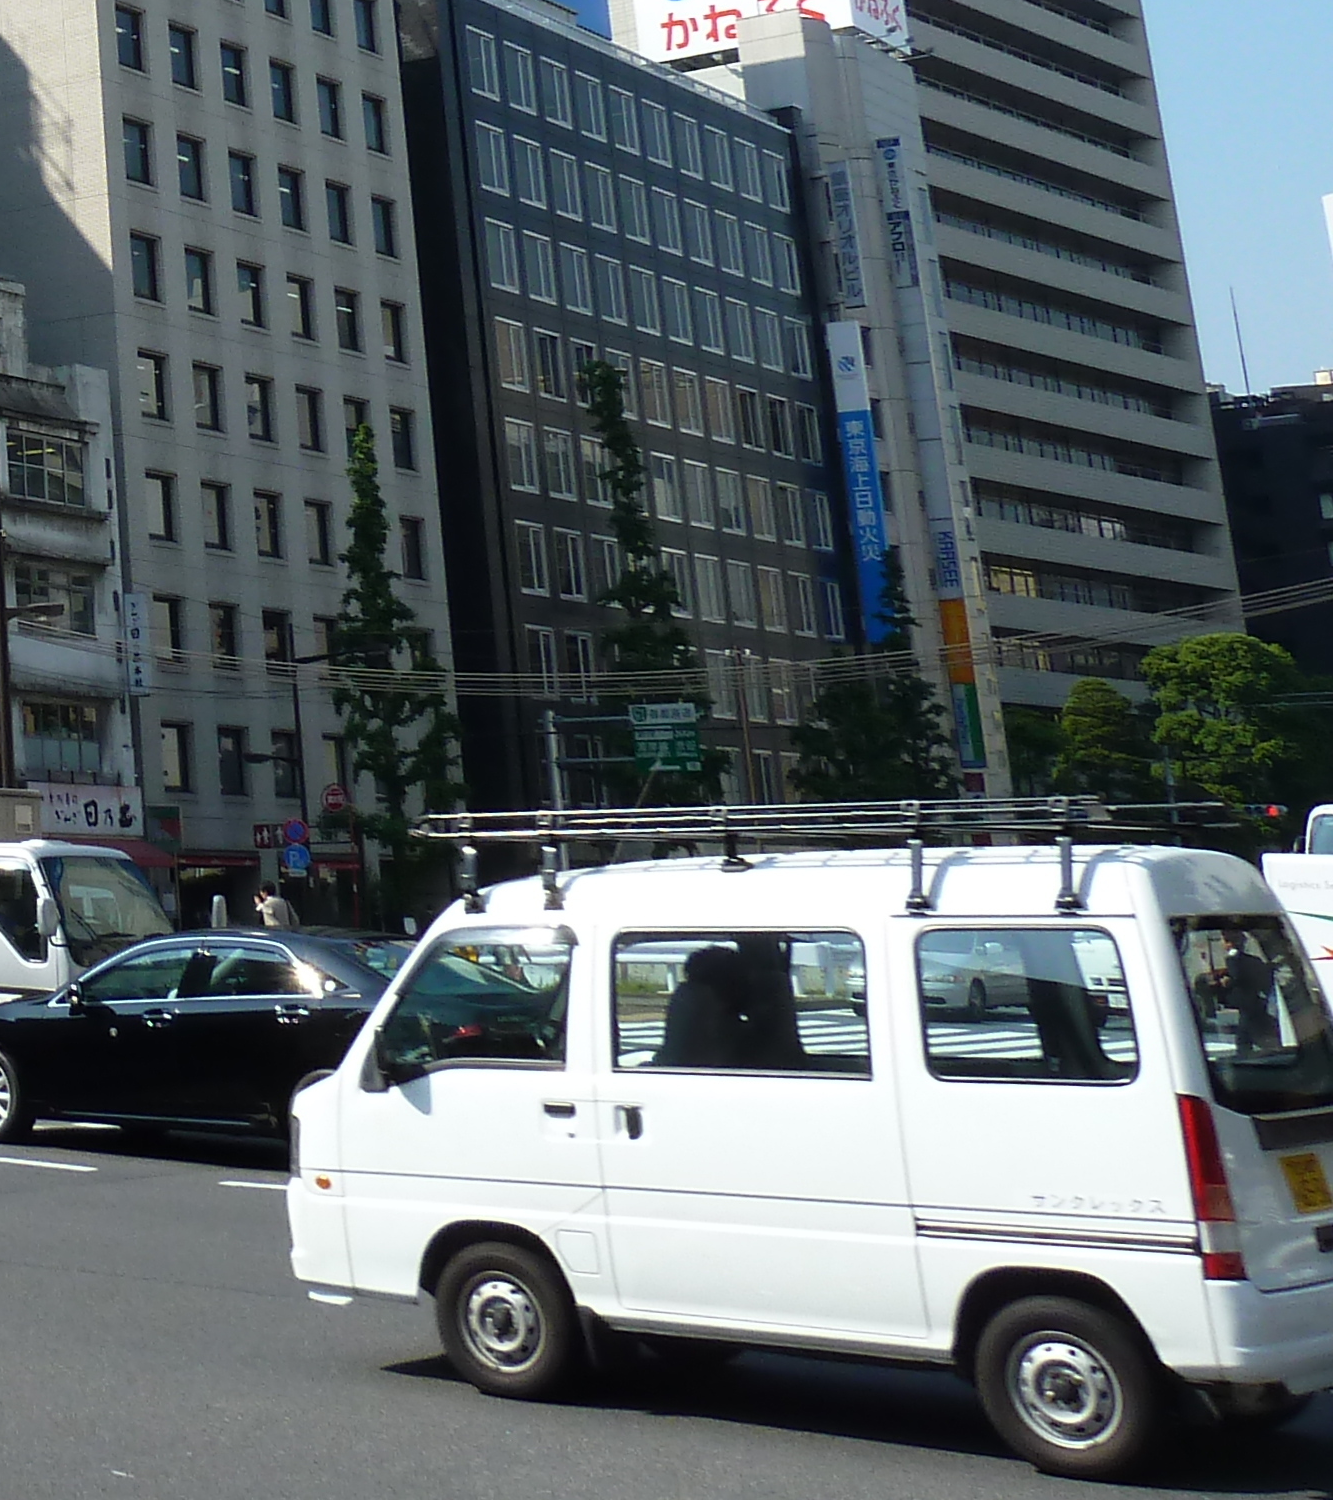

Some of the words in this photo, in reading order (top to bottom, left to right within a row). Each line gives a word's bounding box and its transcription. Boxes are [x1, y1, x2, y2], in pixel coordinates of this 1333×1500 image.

[844, 419, 883, 562] 東京海上日動火災
